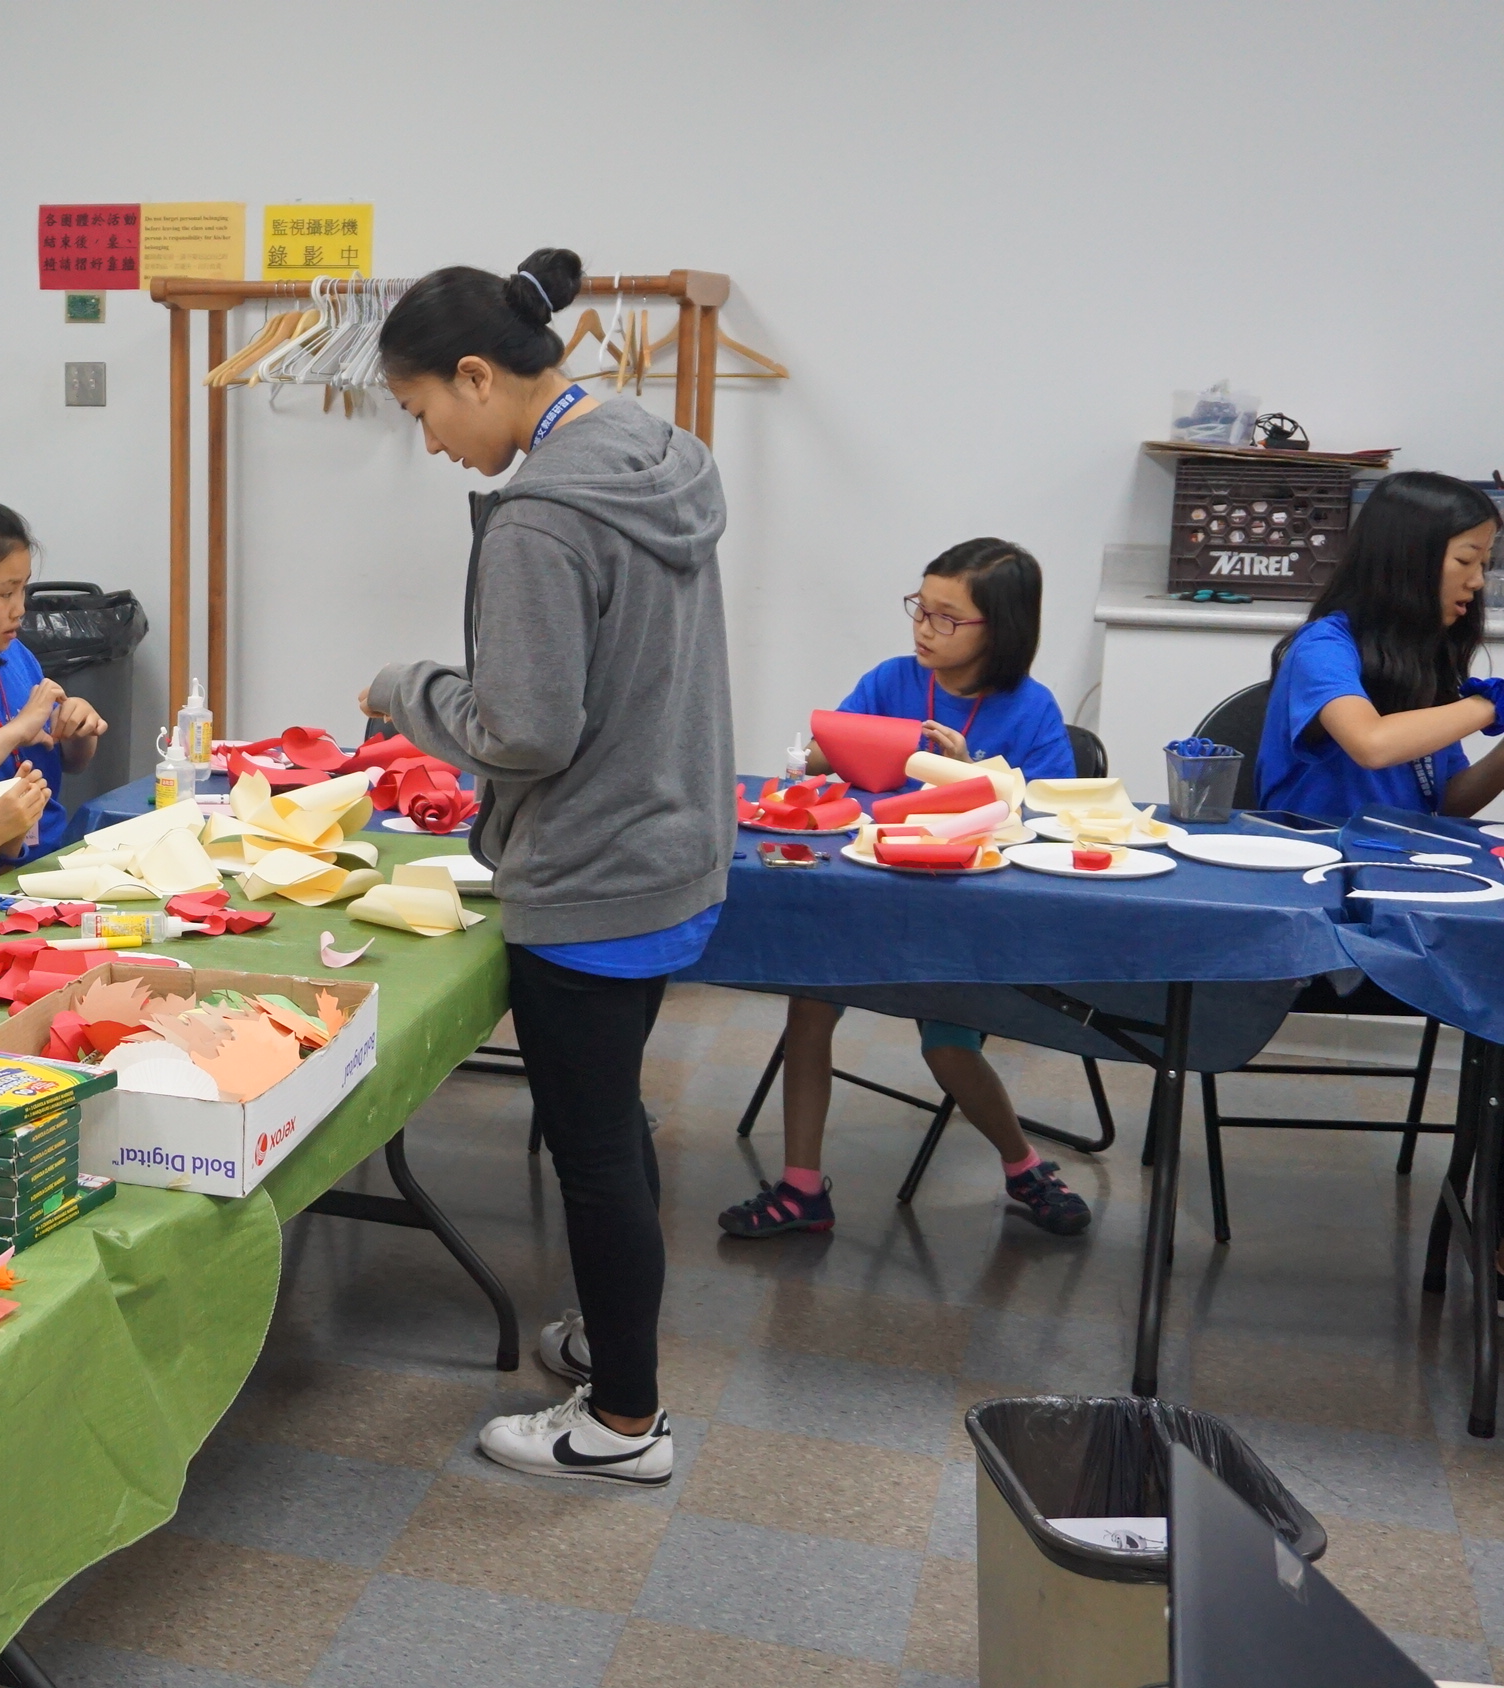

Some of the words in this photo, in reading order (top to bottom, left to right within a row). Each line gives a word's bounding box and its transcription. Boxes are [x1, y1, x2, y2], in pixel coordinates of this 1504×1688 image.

[272, 218, 358, 236] 監視攝影機
[363, 1032, 376, 1060] Bold
[270, 1116, 296, 1150] xerox
[192, 1156, 236, 1178] Bold
